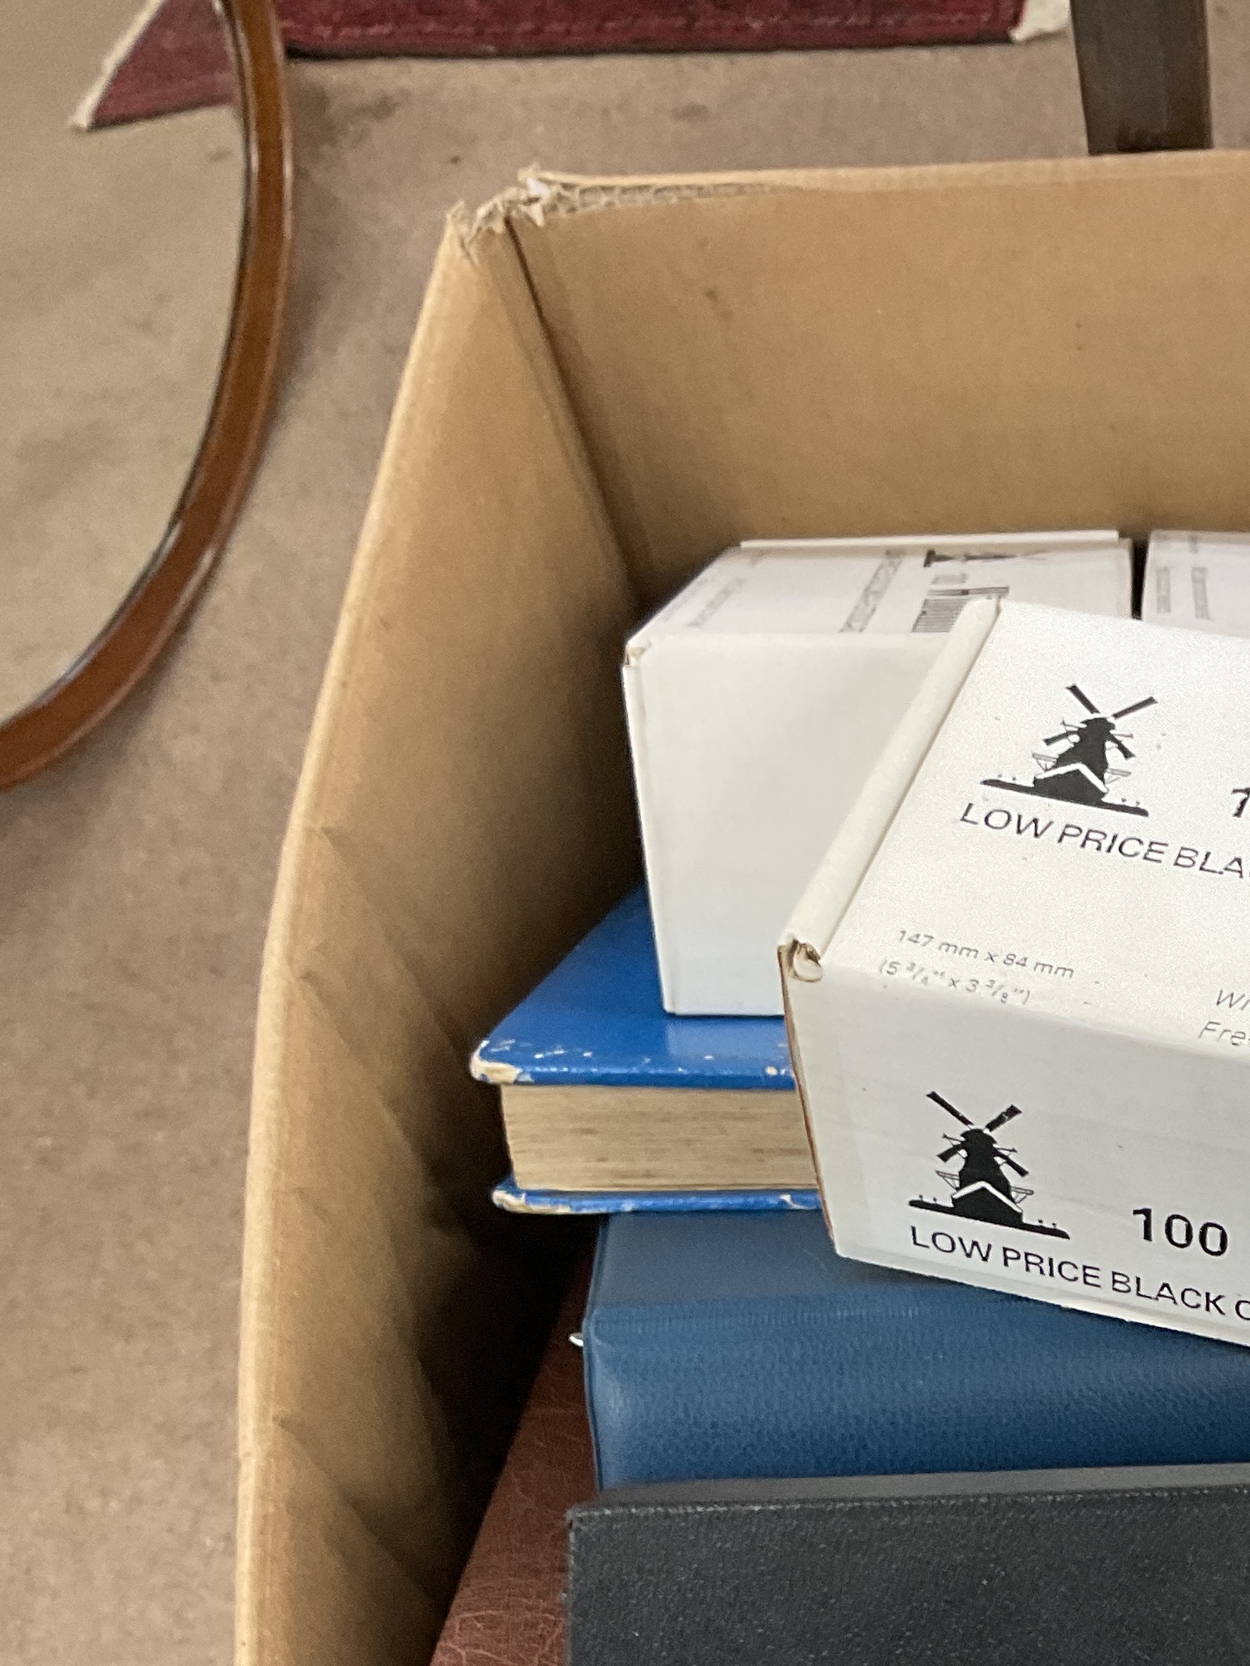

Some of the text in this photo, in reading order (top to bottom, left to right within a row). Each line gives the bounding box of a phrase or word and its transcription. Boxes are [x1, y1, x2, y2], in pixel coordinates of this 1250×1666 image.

[959, 802, 1054, 838] LOW
[1057, 823, 1169, 864] PRICE
[900, 930, 934, 948] 147
[938, 941, 979, 960] mm
[1002, 952, 1029, 968] 84
[1033, 961, 1075, 979] mm
[1132, 1207, 1229, 1257] 100
[910, 1225, 994, 1264] LOW
[1002, 1246, 1102, 1289] PRICE
[1111, 1270, 1227, 1317] BLACK
